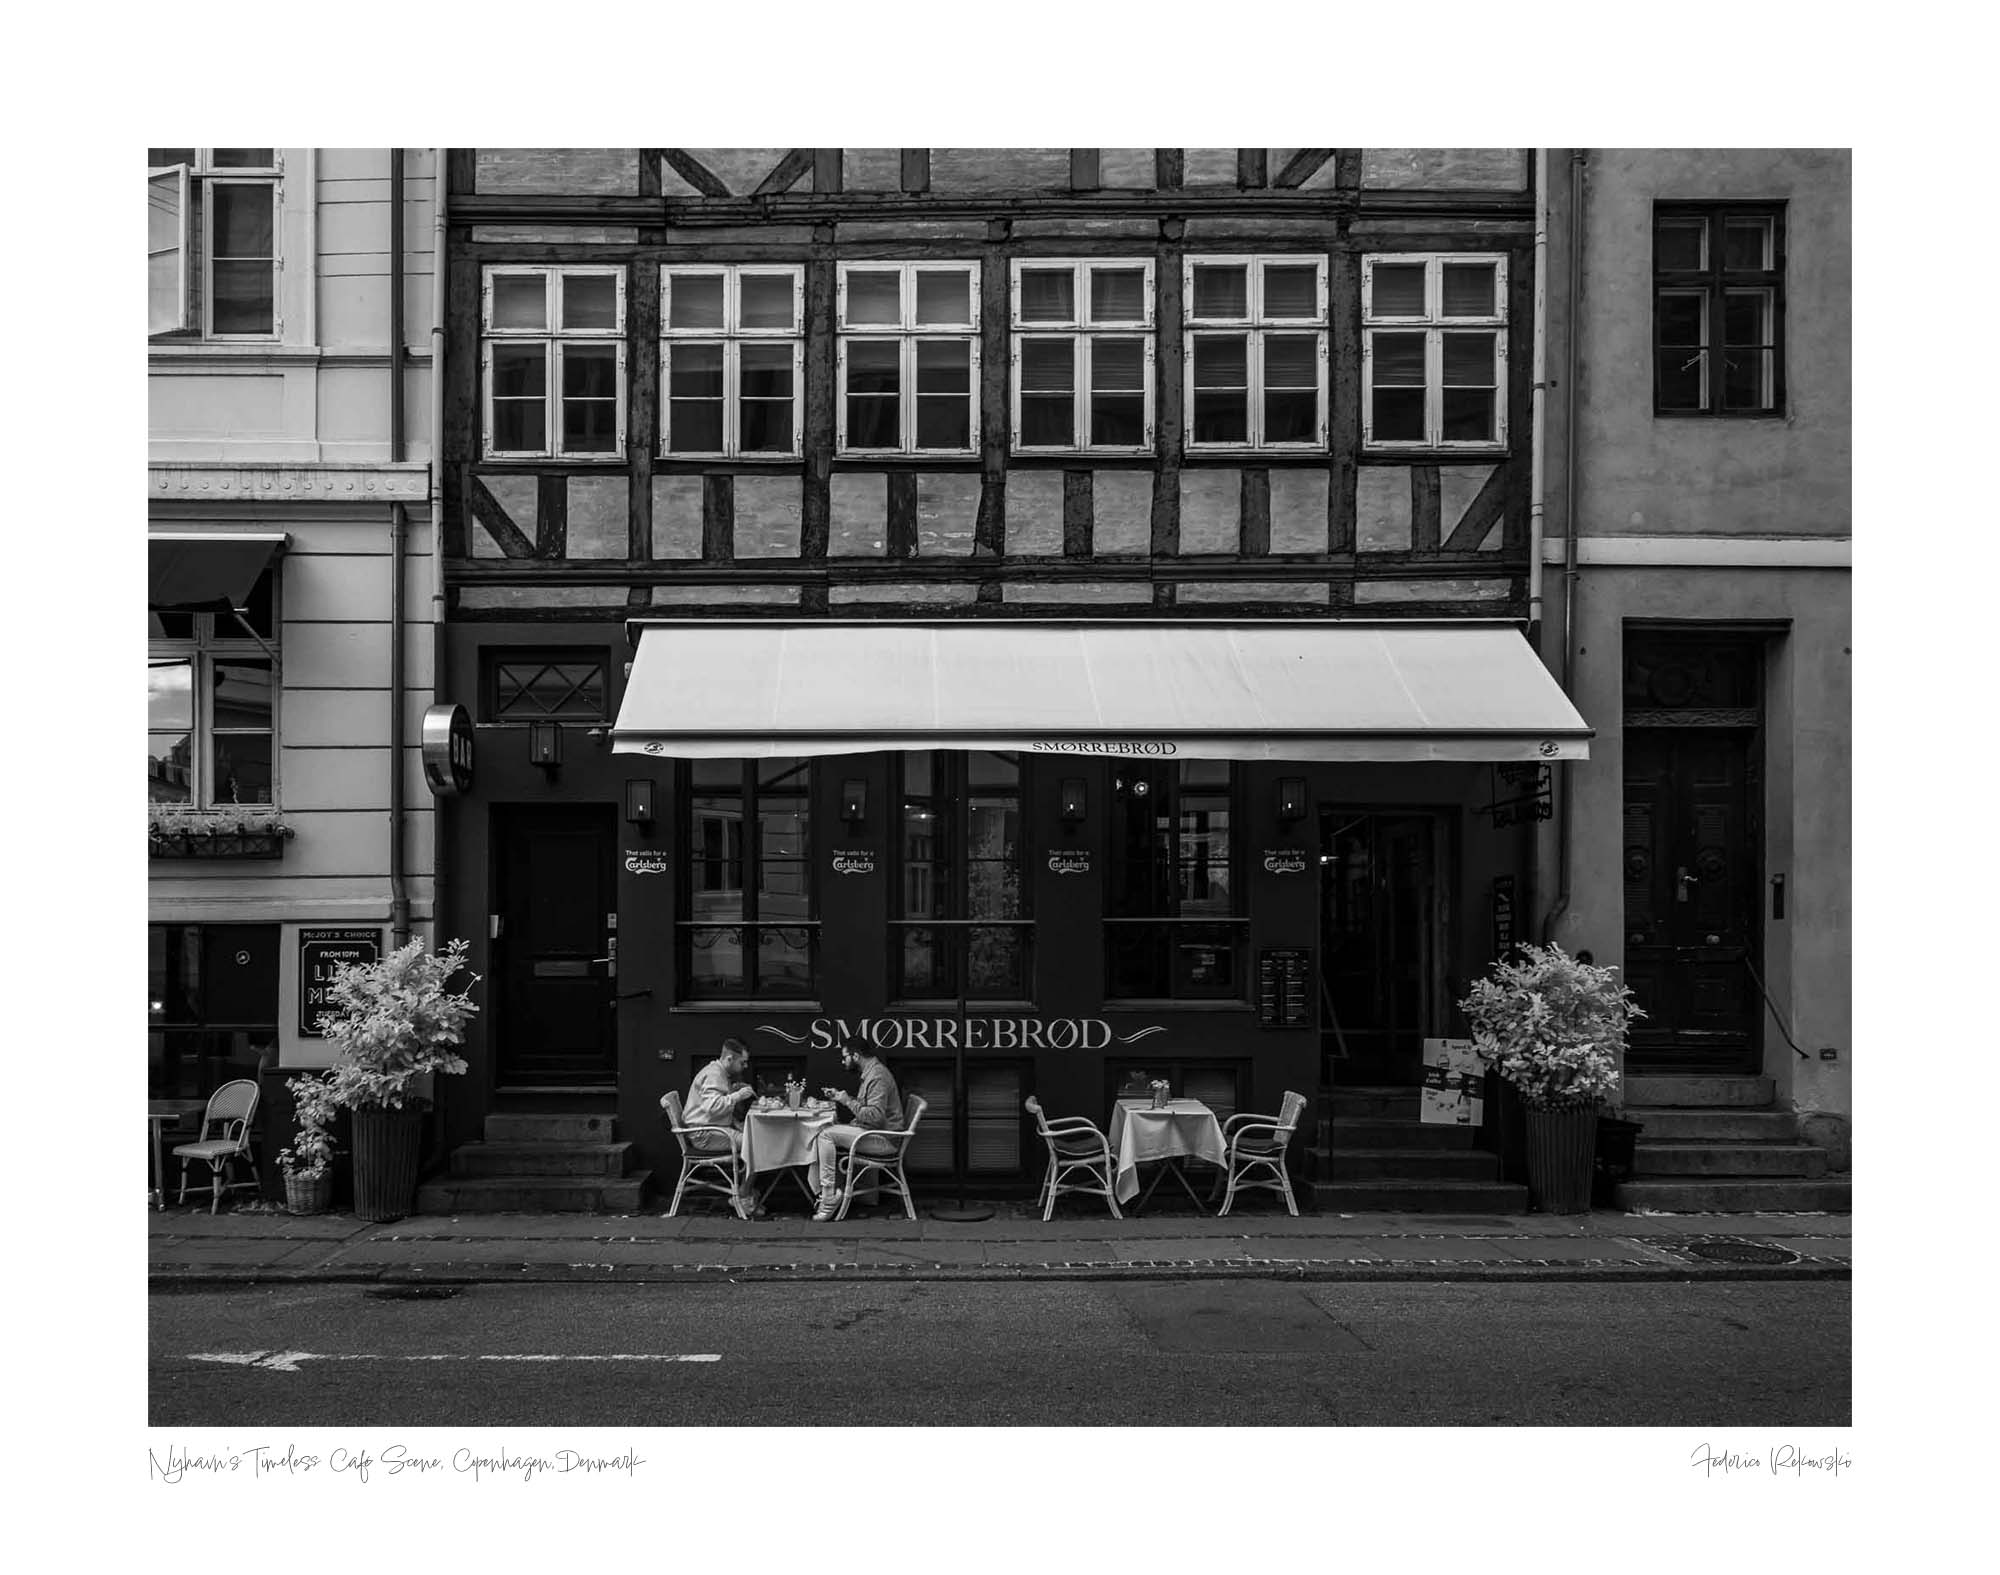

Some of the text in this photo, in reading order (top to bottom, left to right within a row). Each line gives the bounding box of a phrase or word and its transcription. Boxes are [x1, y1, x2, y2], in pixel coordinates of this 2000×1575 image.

[1032, 742, 1177, 755] SMØRREBRØD
[625, 857, 667, 874] Carlsberg
[833, 857, 874, 874] Carlsberg
[1048, 857, 1089, 874] Carlsberg
[1264, 857, 1305, 874] Carlsberg
[320, 950, 340, 958] FROM
[810, 1017, 1112, 1049] SMØRREBRØD
